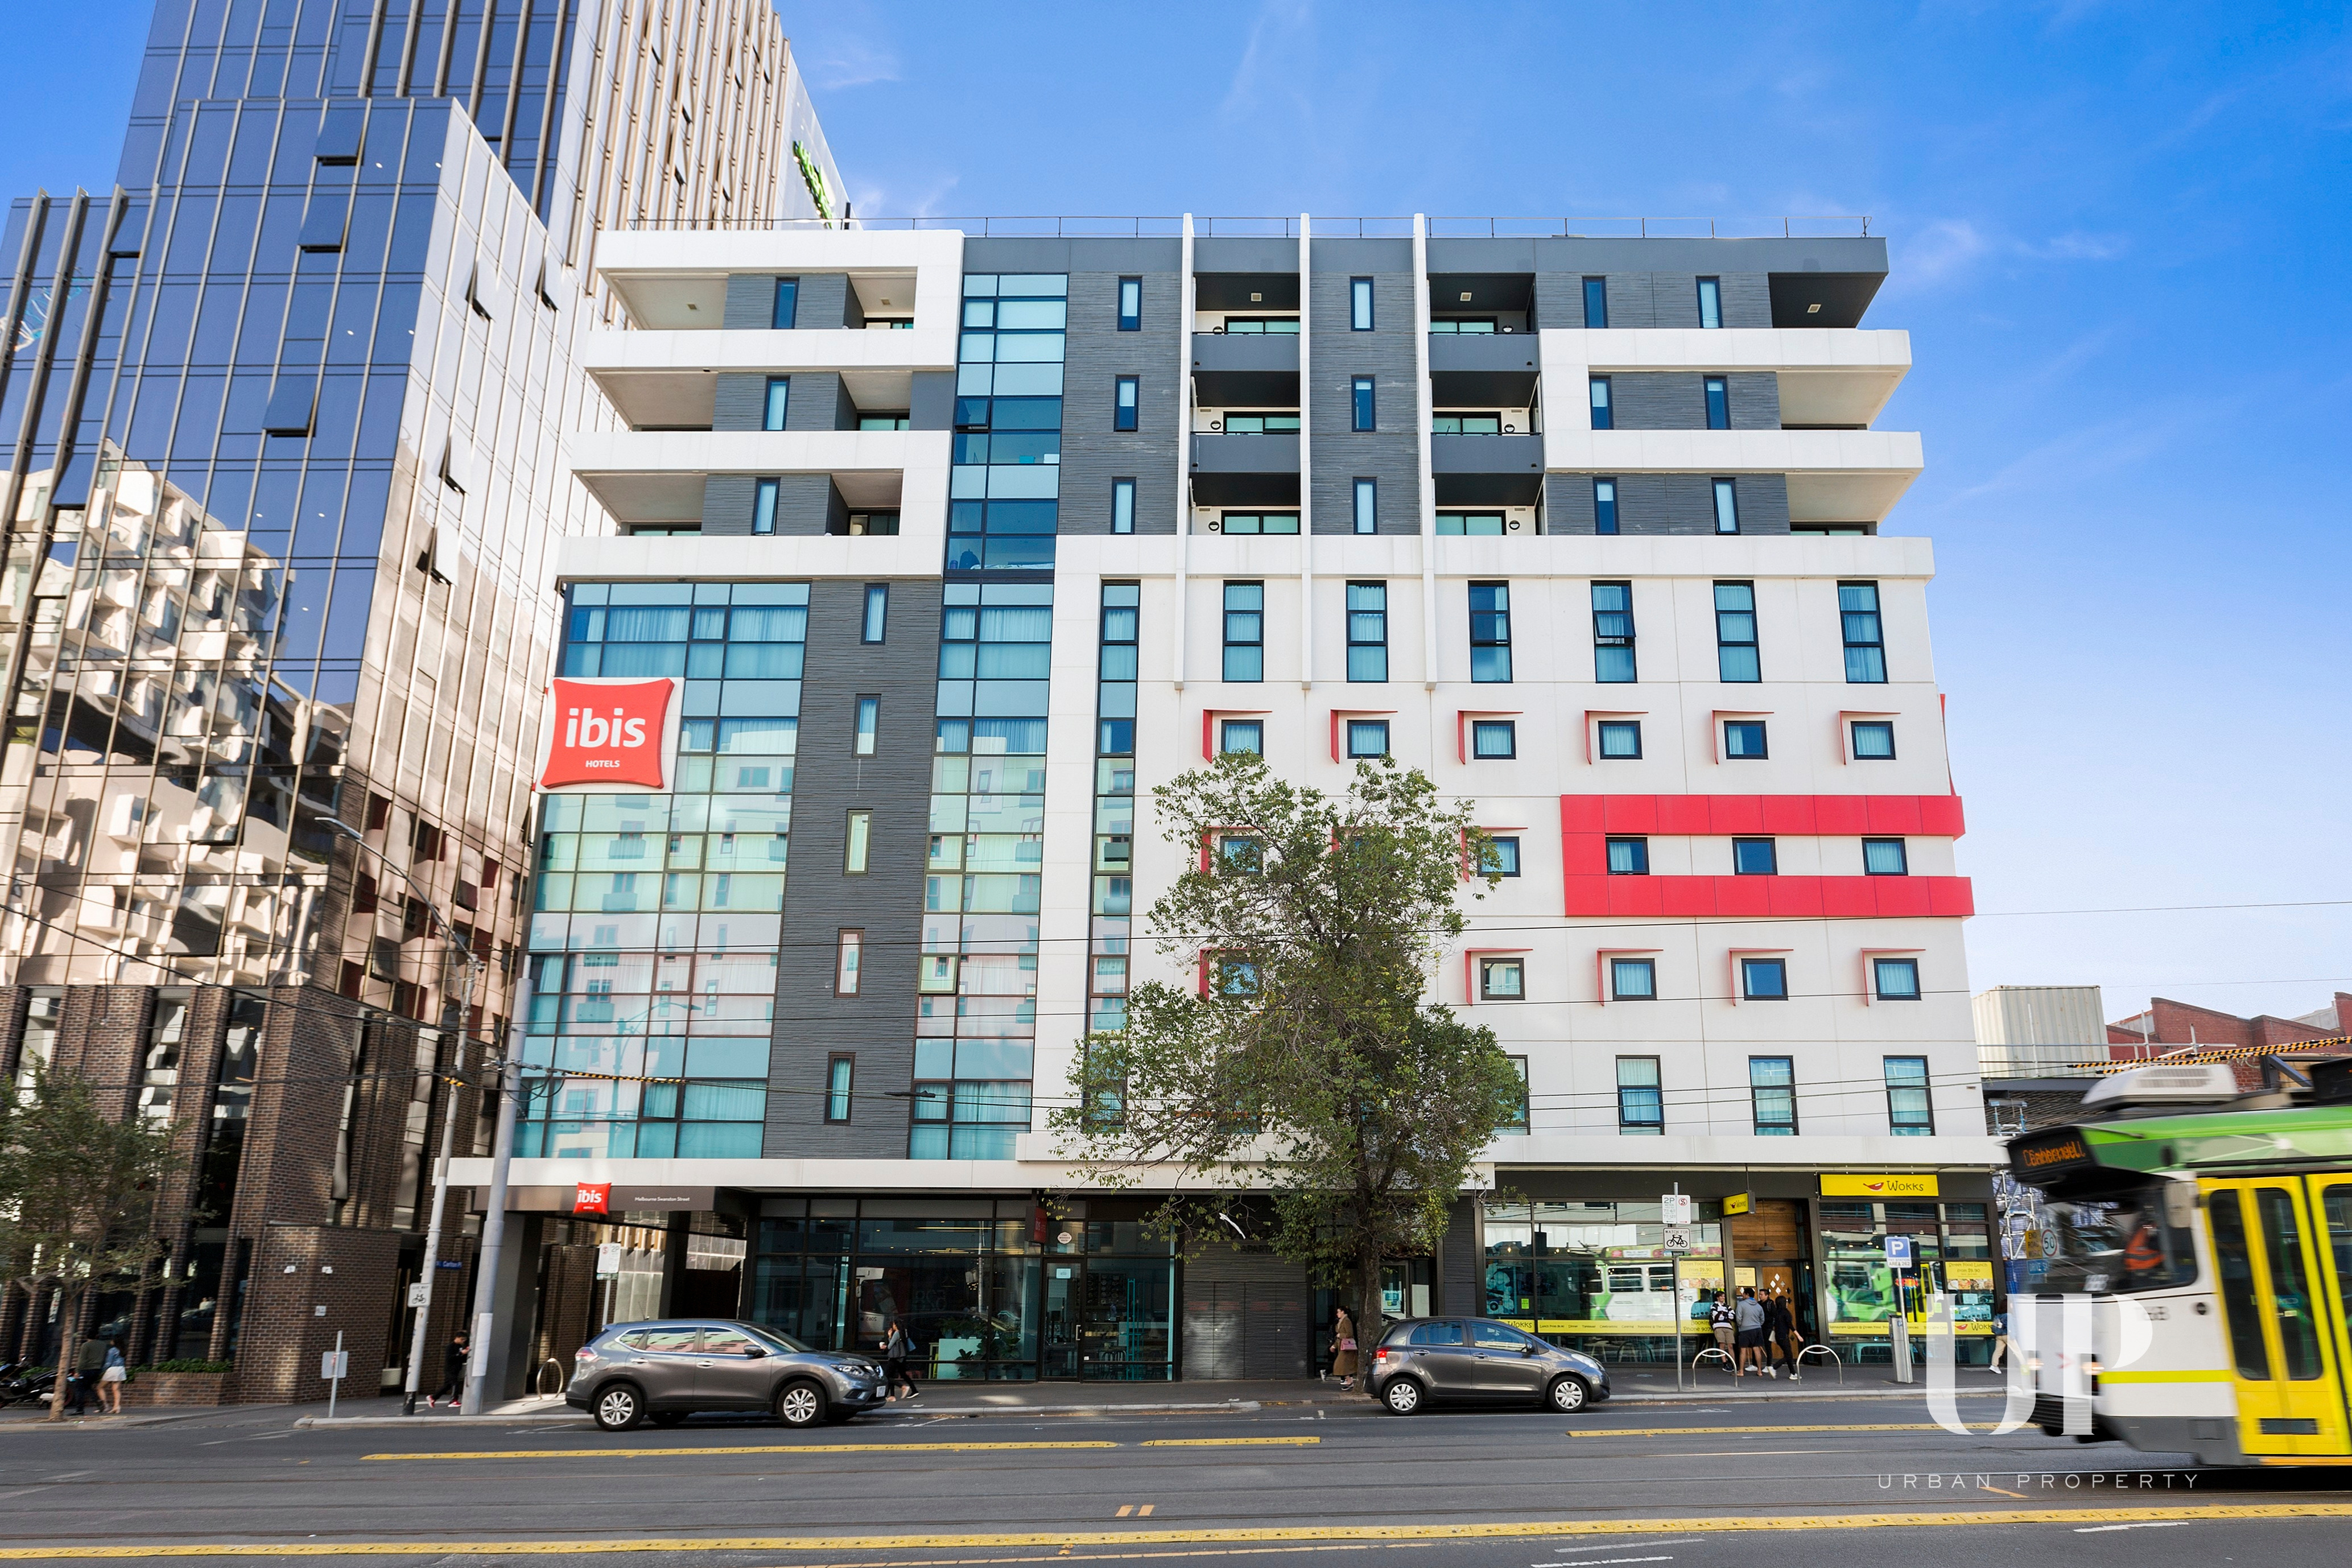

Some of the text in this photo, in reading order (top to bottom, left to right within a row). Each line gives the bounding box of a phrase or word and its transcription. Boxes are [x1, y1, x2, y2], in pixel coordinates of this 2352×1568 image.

[565, 707, 646, 748] ibis
[585, 760, 621, 768] HOTELS
[577, 1189, 603, 1203] ibis
[1891, 1241, 1904, 1256] P
[2044, 1237, 2055, 1249] 50
